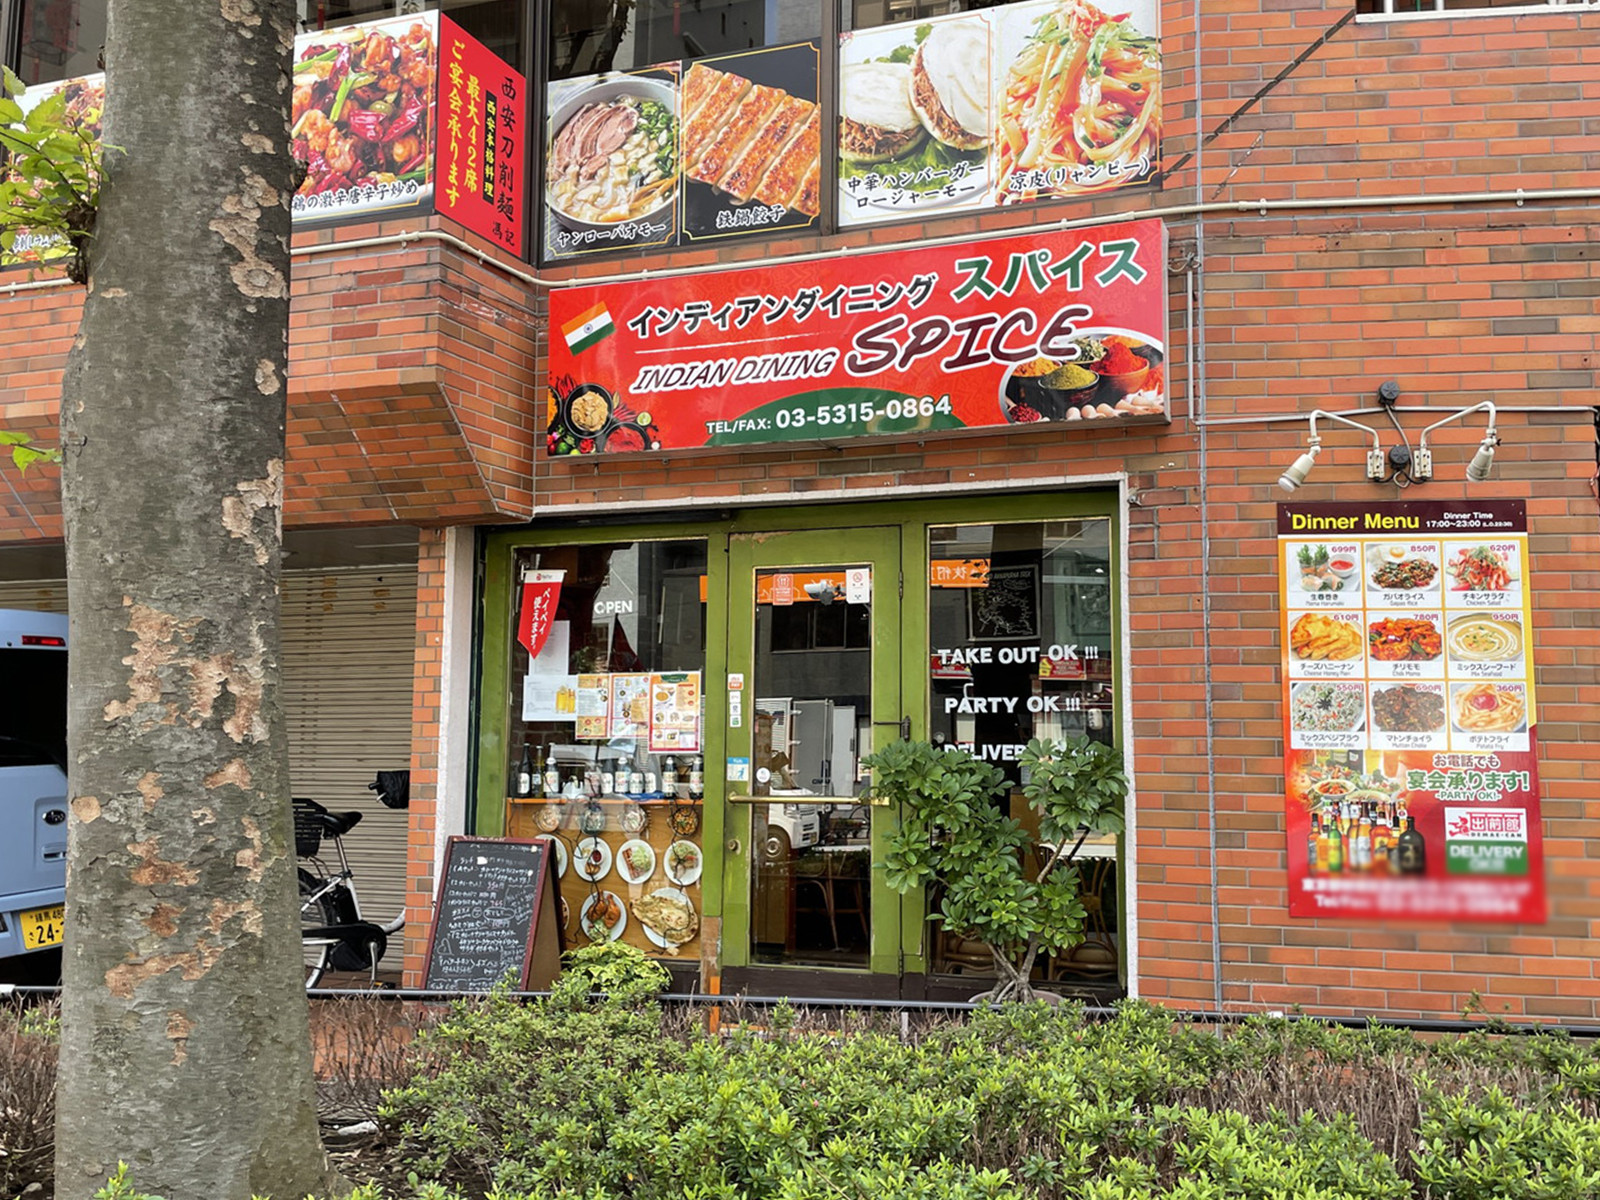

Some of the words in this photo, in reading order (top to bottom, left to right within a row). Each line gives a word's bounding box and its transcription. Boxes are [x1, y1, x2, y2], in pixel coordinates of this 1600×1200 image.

[446, 39, 466, 208] ご宴会承ります
[847, 163, 985, 194] 中華ハンバーガー
[856, 182, 976, 208] ロージャーモー
[716, 203, 787, 228] 鉄鍋餃子
[629, 274, 937, 336] インディアンダイニング
[953, 240, 1145, 299] スパイス
[631, 358, 736, 392] INDIAN
[733, 350, 837, 382] DINING
[849, 307, 1090, 374] SPICE
[706, 418, 771, 433] TEL/FAX:
[775, 396, 951, 429] 03-5315-0864
[1292, 514, 1359, 530] Dinner
[1364, 513, 1419, 529] Menu
[1463, 592, 1504, 600] チキンサラダ
[594, 600, 633, 614] OPEN
[937, 648, 992, 664] TAKE
[998, 647, 1040, 665] OUT
[1048, 644, 1078, 661] OK
[1085, 646, 1099, 659] !!!
[944, 697, 1019, 713] PARTY
[1027, 695, 1060, 713] OK
[1066, 698, 1080, 711] !!!
[1433, 754, 1500, 768] お電話でも
[1407, 771, 1529, 791] 宴会承ります!
[1449, 845, 1524, 859] DELIVERY
